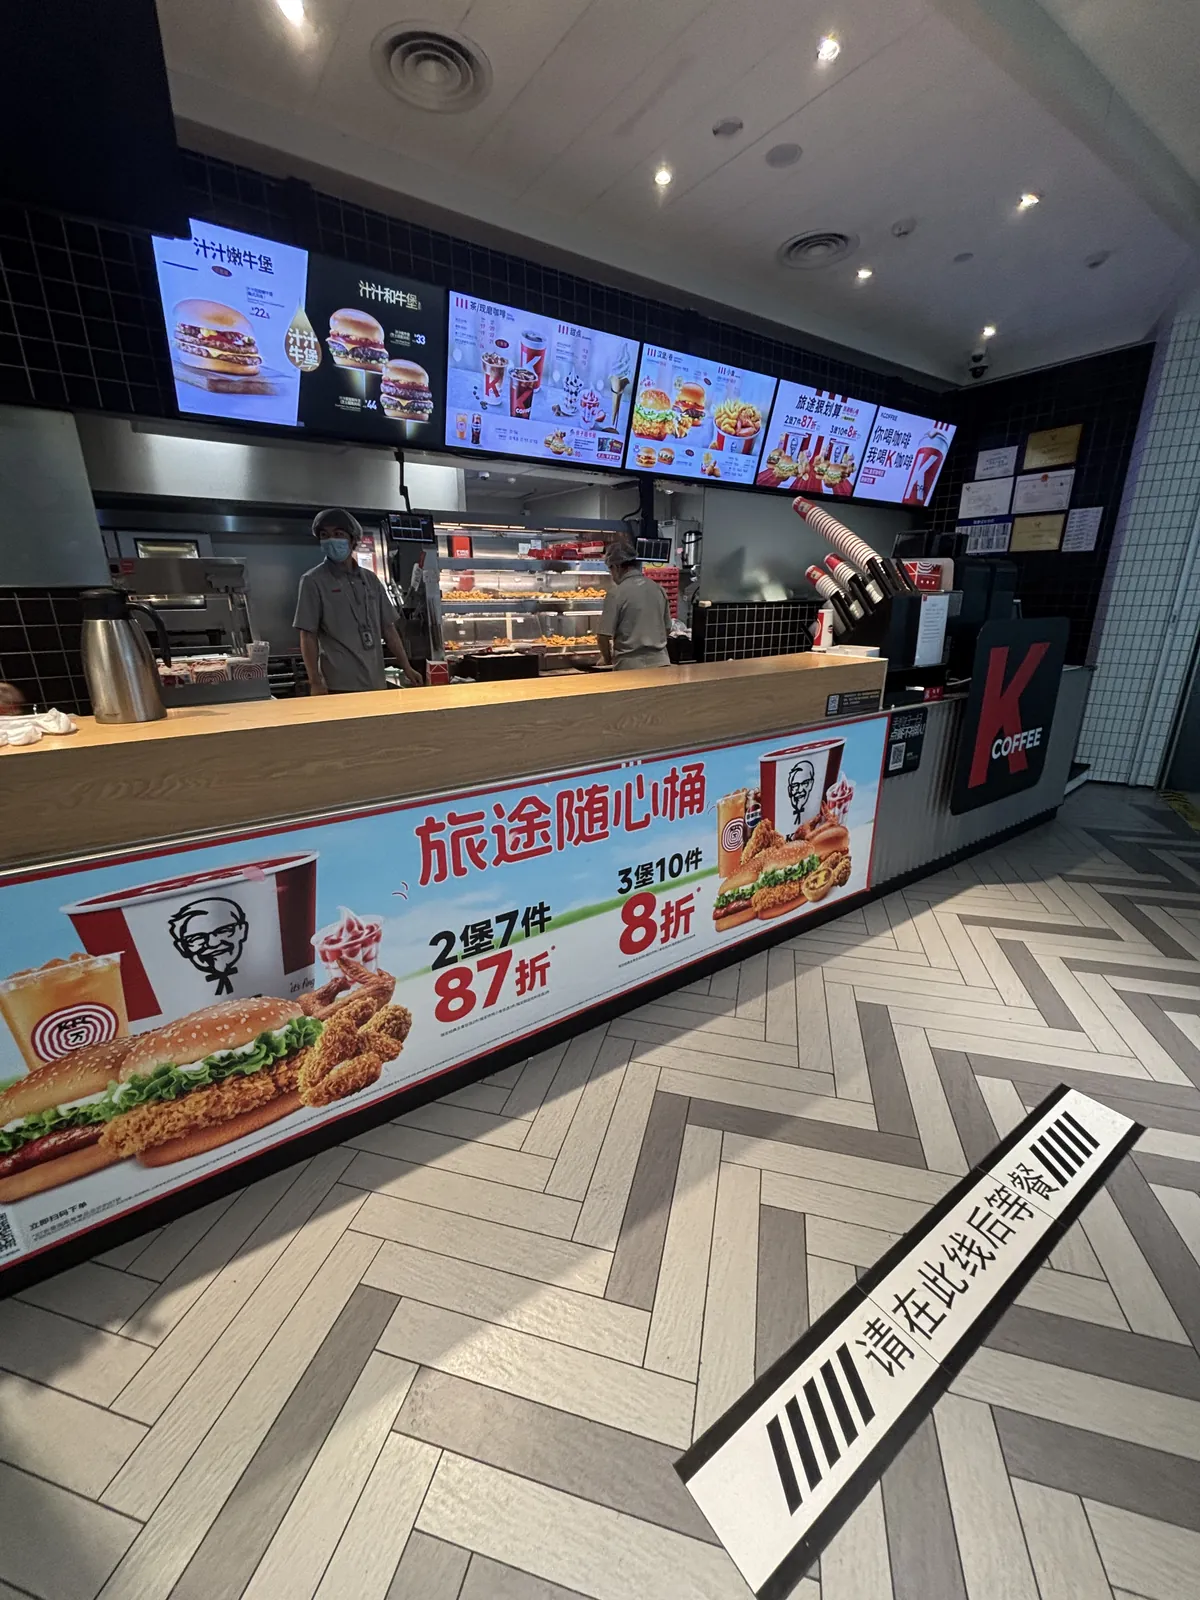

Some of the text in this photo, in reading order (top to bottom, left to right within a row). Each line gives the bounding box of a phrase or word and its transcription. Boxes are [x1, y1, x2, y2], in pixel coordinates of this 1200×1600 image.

[193, 237, 274, 275] 汁汁嫩牛堡
[358, 280, 418, 310] 汁汁和牛堡
[288, 328, 318, 348] 汁汁
[485, 373, 500, 398] K
[873, 425, 912, 449] 你喝咖啡
[866, 446, 914, 470] 我喝K咖啡
[968, 642, 1050, 789] K
[991, 727, 1043, 760] COFFEE
[415, 763, 706, 886] 旅途随心桶
[617, 847, 703, 894] 3堡10件
[429, 901, 552, 971] 2堡7件
[434, 948, 552, 1023] 87折
[30, 1201, 87, 1231] 立即扫码下单
[855, 1162, 1060, 1378] 请在此线后等餐
